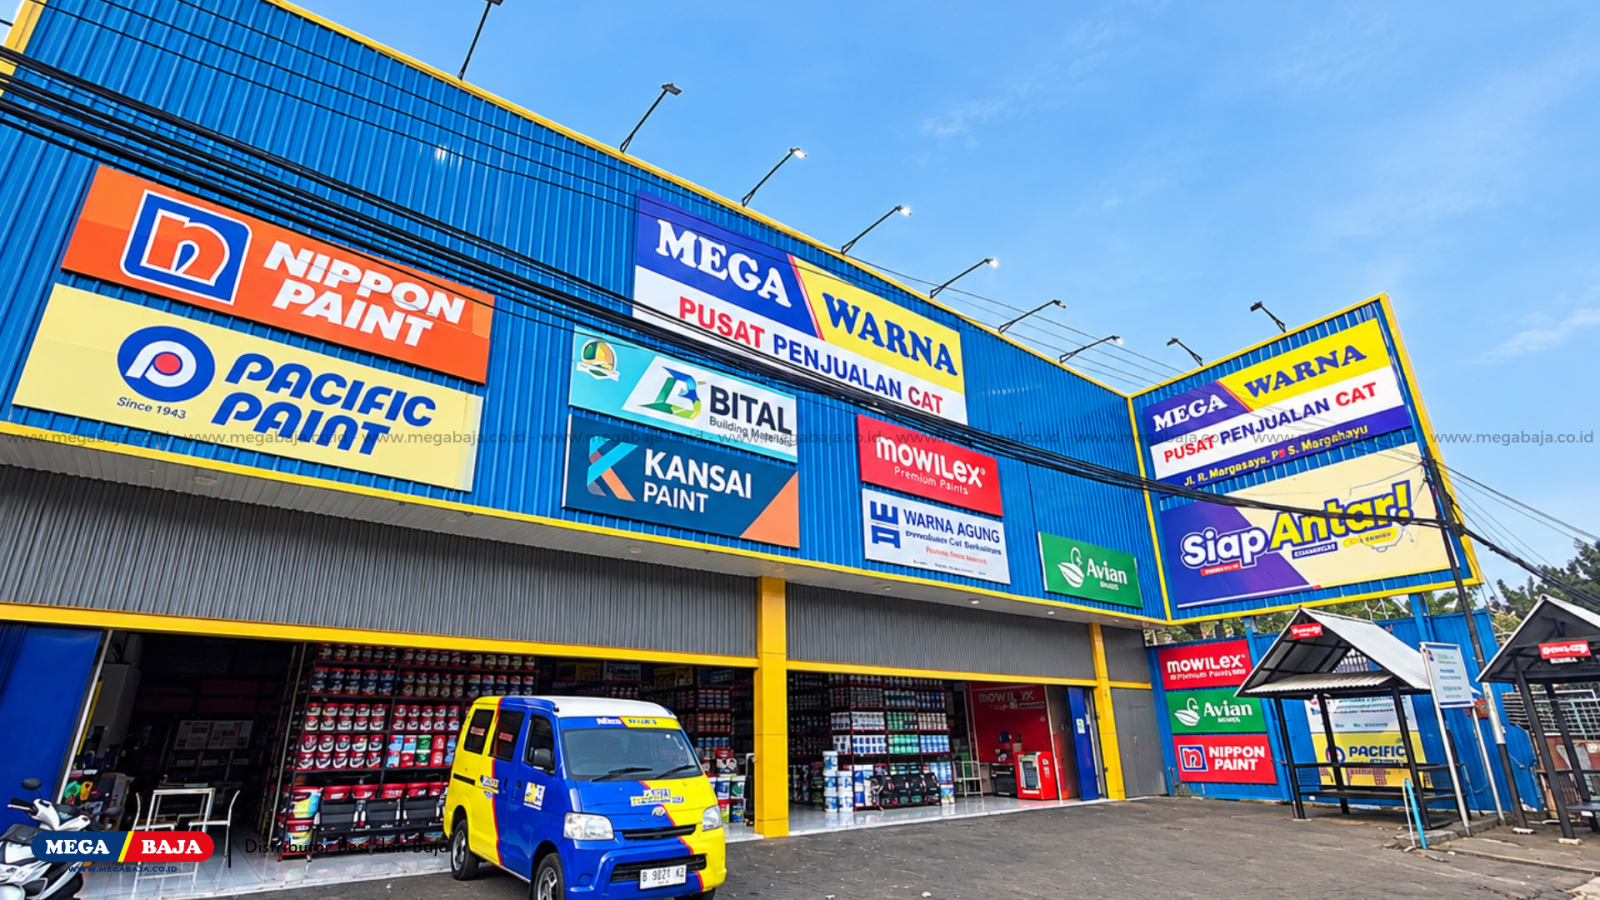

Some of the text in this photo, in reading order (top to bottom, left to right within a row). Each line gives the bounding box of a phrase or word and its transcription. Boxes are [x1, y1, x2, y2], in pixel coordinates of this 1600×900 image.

[264, 241, 466, 323] NIPPON
[655, 218, 792, 308] MEGA
[273, 278, 434, 347] PAINT
[821, 292, 959, 377] WARNA
[679, 296, 943, 414] PUSAT PENJUALAN CAT
[1243, 344, 1368, 399] WARNA
[116, 396, 187, 419] Since 1943
[224, 352, 437, 428] PACIFIC
[709, 384, 792, 436] BITAL
[211, 391, 391, 456] PAINT
[709, 416, 749, 438] Building
[1152, 394, 1228, 433] MEGA
[1163, 382, 1378, 463] PUSAT PENJUALAN CAT
[644, 448, 753, 499] KANSAI
[894, 466, 937, 487] Premium
[643, 481, 709, 513] PAINT
[1268, 480, 1414, 552] Antar!
[903, 509, 954, 535] WARNA
[957, 522, 1001, 544] AGUNG
[1182, 528, 1268, 568] Siap
[1086, 558, 1128, 585] Avian
[1203, 700, 1253, 717] Avian
[1208, 746, 1266, 758] NIPPON
[1214, 758, 1259, 771] PAINT
[1348, 745, 1406, 758] PACIFIC
